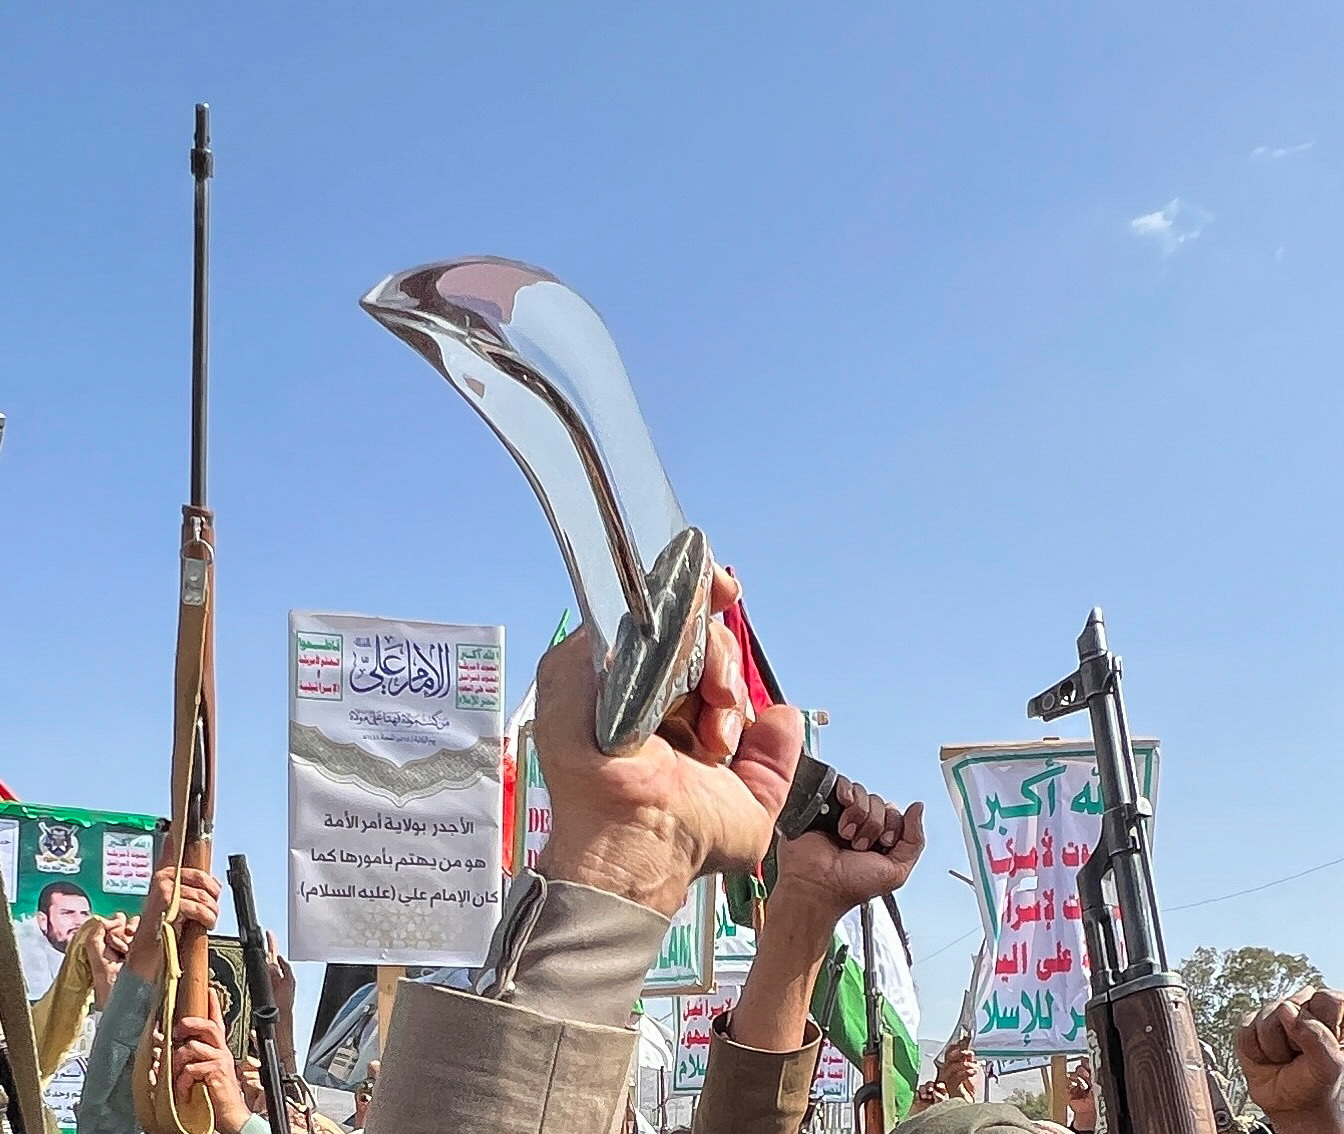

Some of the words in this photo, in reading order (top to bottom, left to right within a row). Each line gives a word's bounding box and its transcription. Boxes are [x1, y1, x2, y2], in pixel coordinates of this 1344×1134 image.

[978, 758, 1068, 836] أكبر
[324, 811, 359, 829] الأمة
[361, 813, 382, 833] أمر
[385, 815, 426, 835] بولاية
[432, 817, 474, 836] الأجدر
[311, 848, 336, 863] كما
[340, 847, 393, 869] بأمورها
[395, 852, 436, 871] يهتم
[439, 859, 461, 872] من
[466, 858, 486, 873] هو
[430, 889, 470, 908] الإمام
[472, 890, 499, 908] كان
[1037, 941, 1073, 981] على
[978, 989, 1055, 1047] للإسلا
